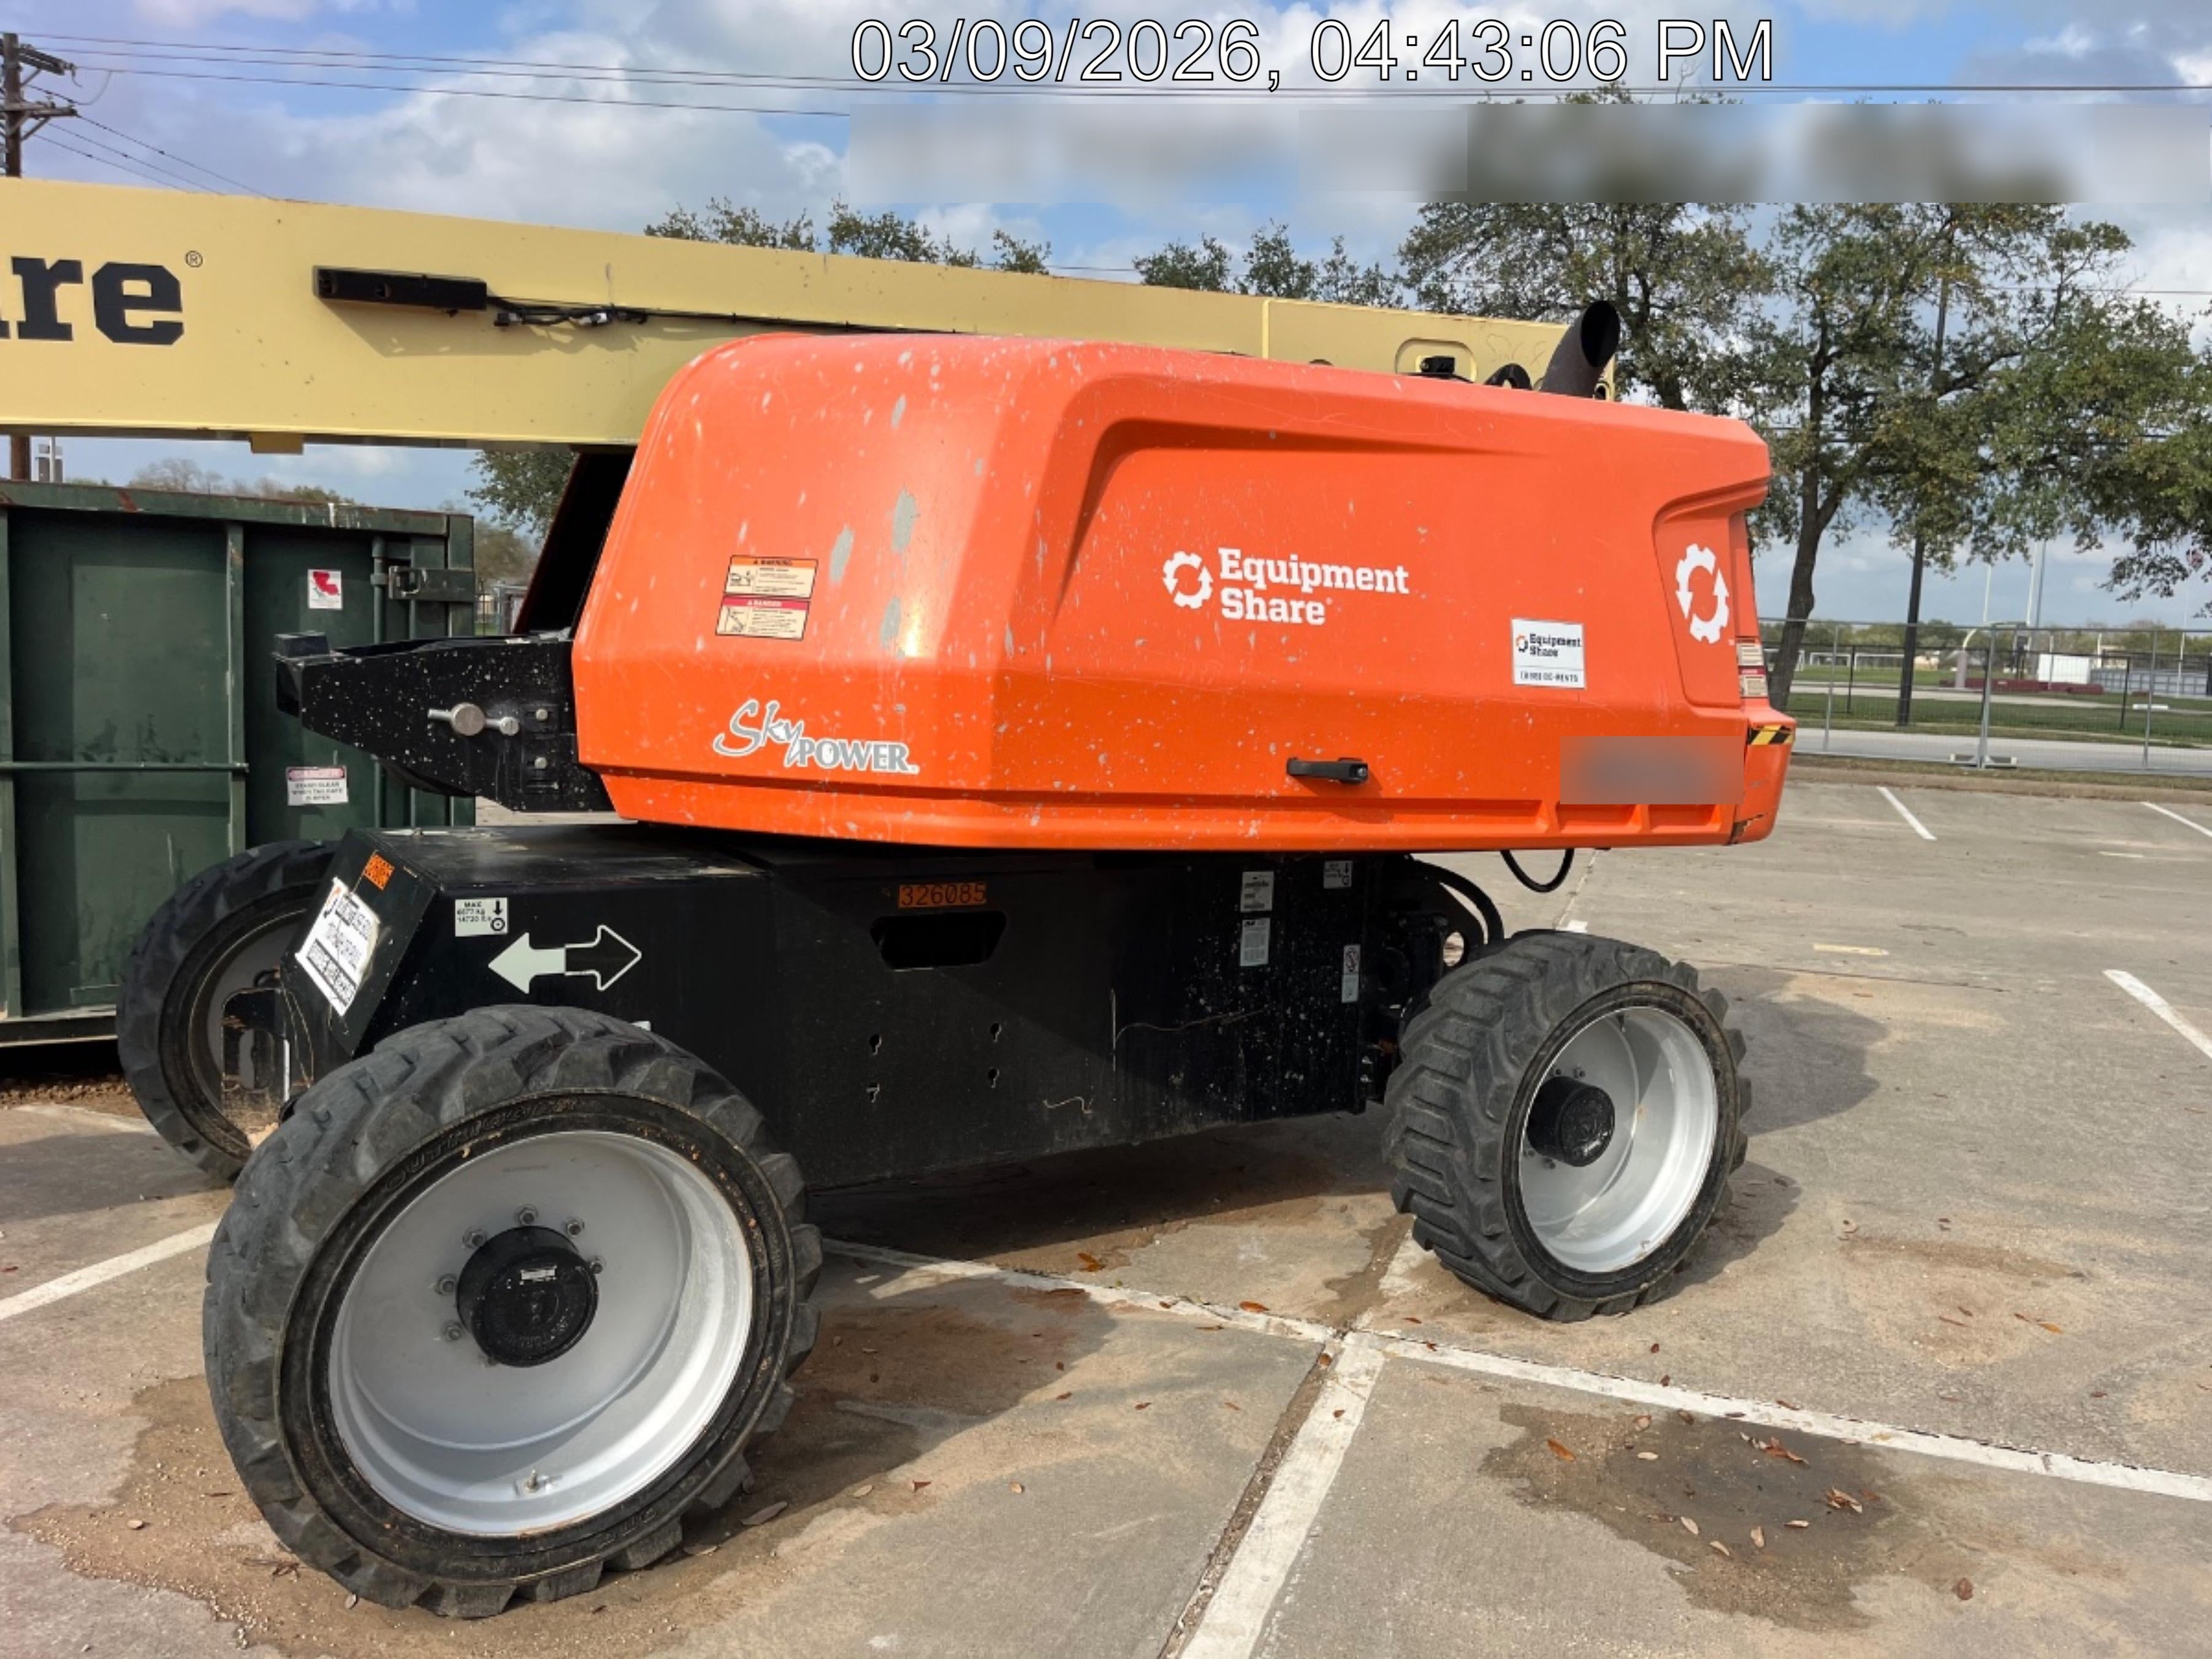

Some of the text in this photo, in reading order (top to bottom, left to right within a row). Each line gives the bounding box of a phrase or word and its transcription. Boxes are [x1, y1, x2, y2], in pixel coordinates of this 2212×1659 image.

[1218, 547, 1410, 595] Equipment
[1220, 587, 1327, 626] Share
[1529, 633, 1582, 648] Equipment
[901, 884, 986, 906] 326085
